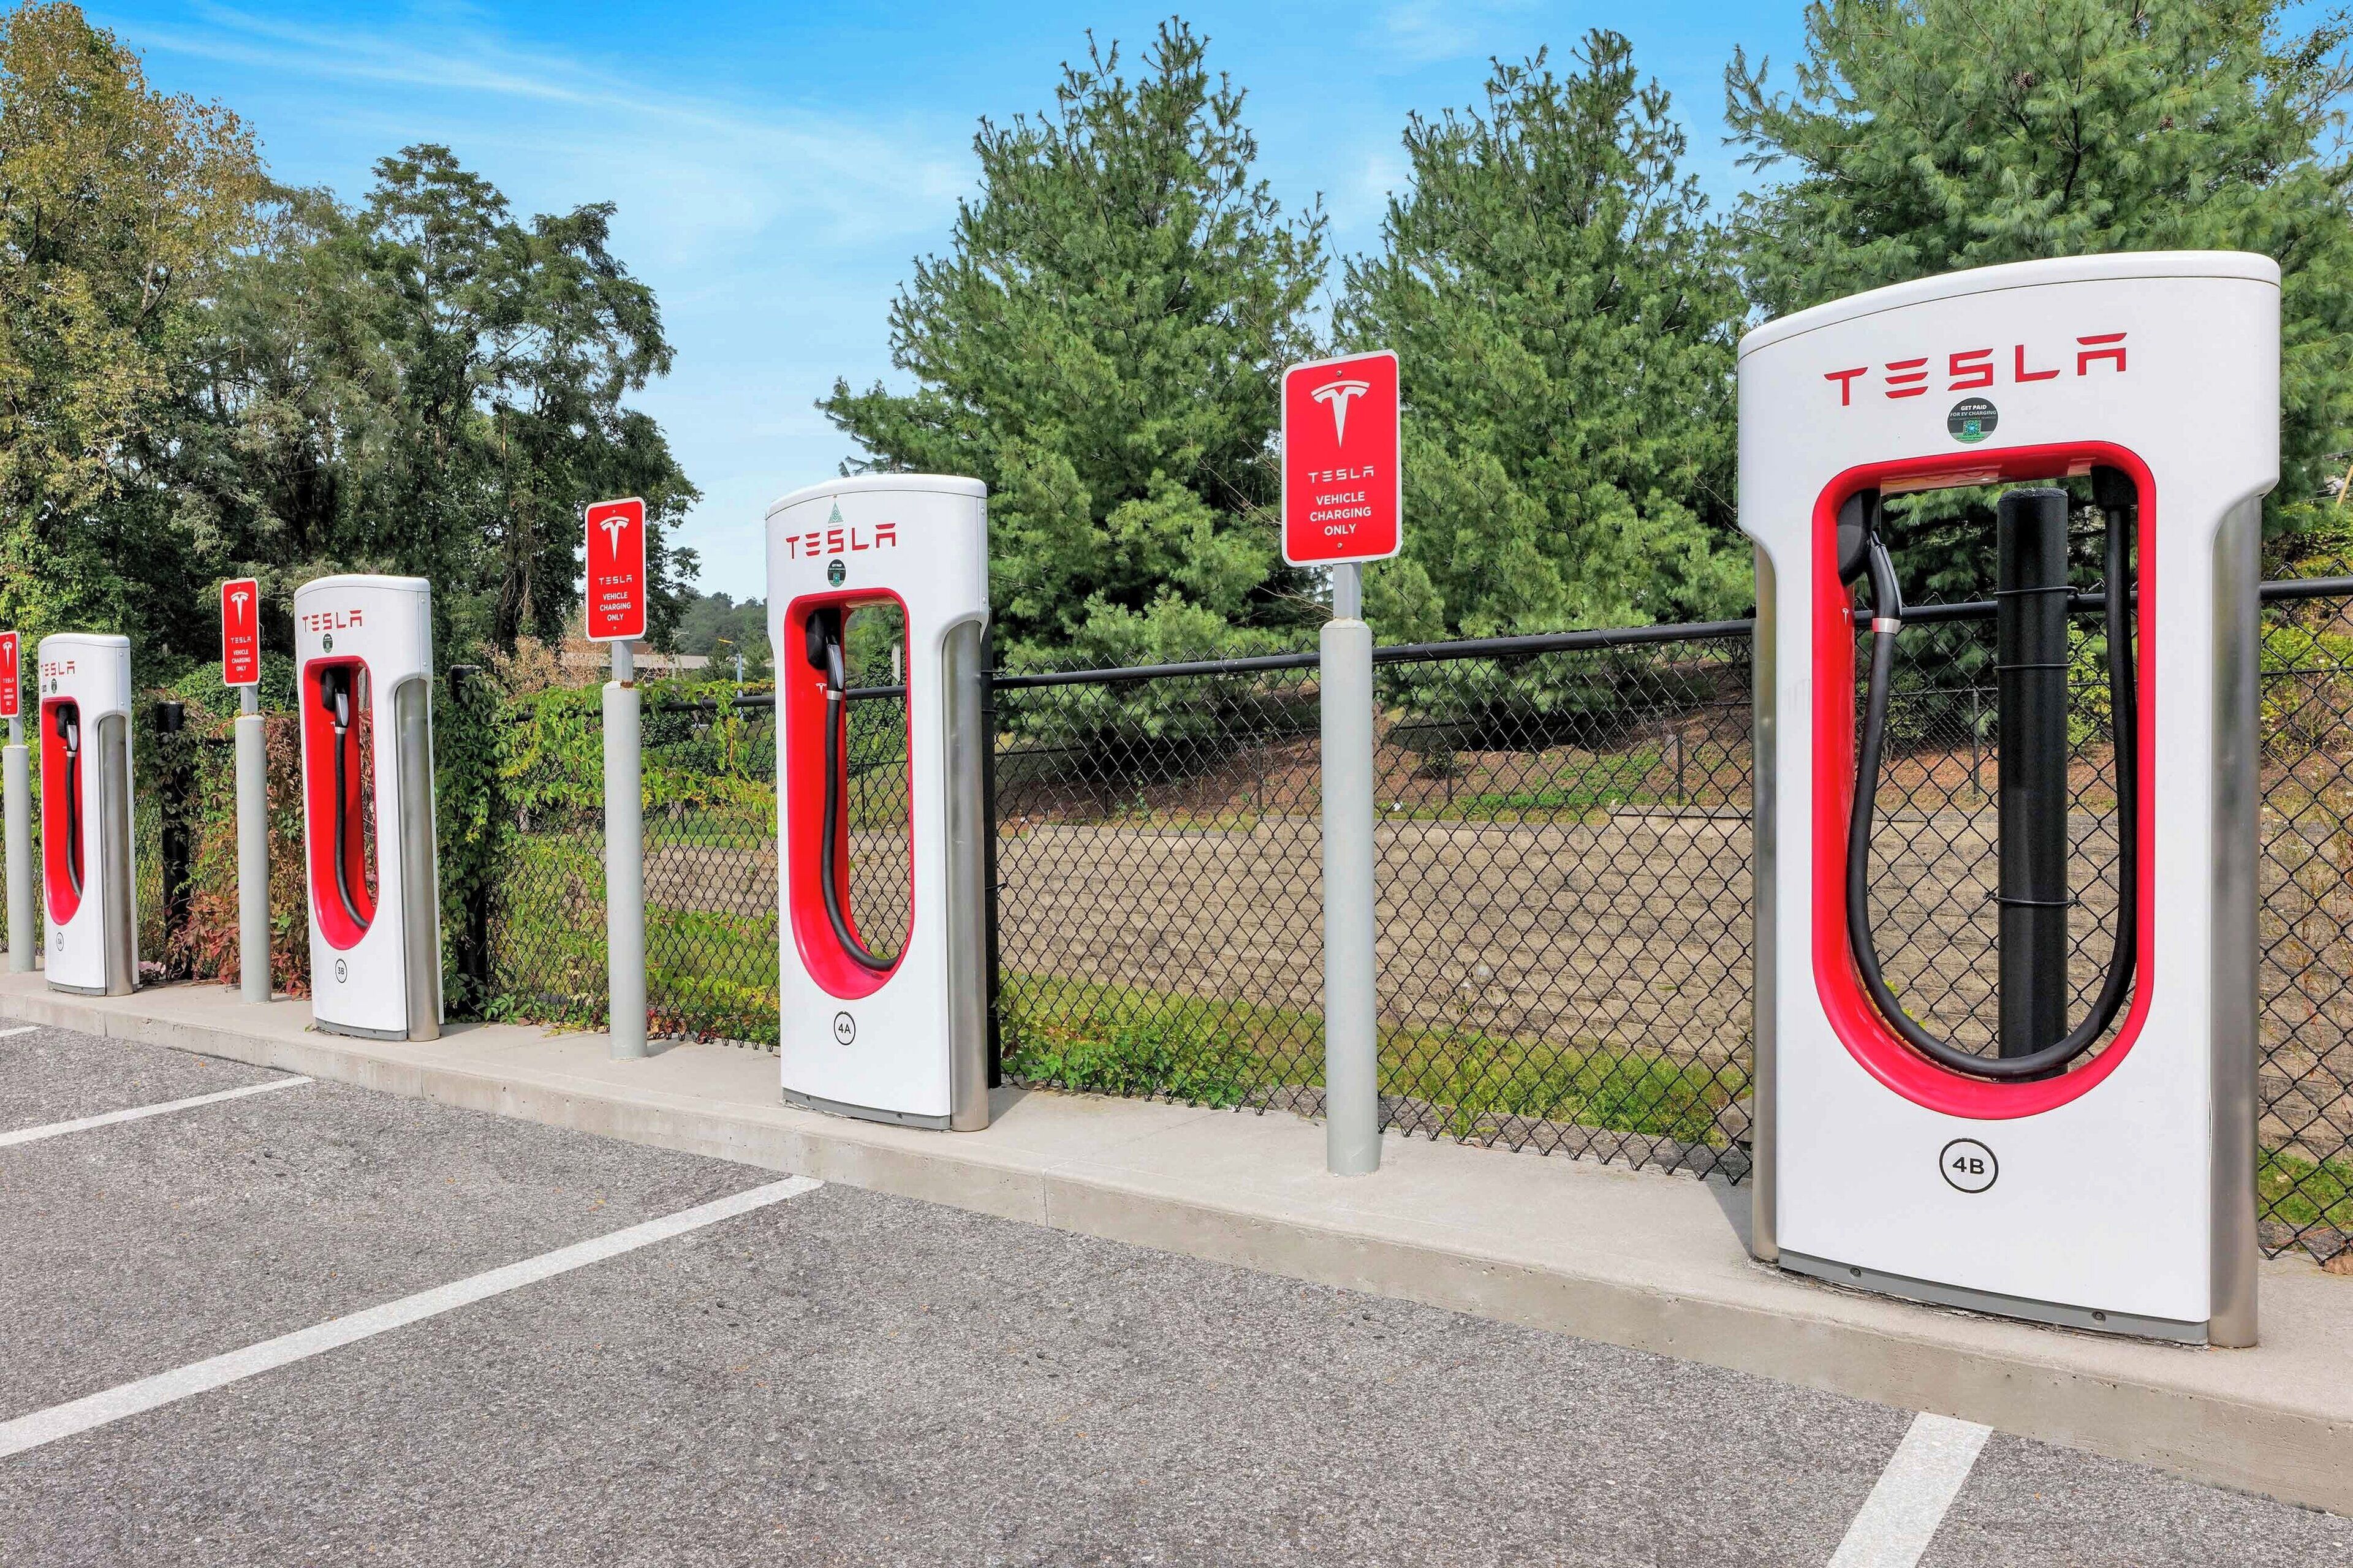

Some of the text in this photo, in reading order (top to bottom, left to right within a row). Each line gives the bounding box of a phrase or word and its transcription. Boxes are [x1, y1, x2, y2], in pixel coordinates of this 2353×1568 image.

[1824, 332, 2127, 406] TESLA
[1308, 466, 1373, 483] TESLA
[1316, 491, 1365, 506] VEHICLE
[1309, 506, 1371, 522] CHARGING
[1324, 523, 1357, 536] ONLY
[786, 523, 896, 559] TESLA
[599, 575, 632, 585] TESLA
[603, 592, 627, 600] VEHICLE
[600, 602, 631, 612] CHARGING
[301, 609, 363, 632] TESLA
[838, 1023, 851, 1034] 4A
[1952, 1157, 1985, 1174] 4B
